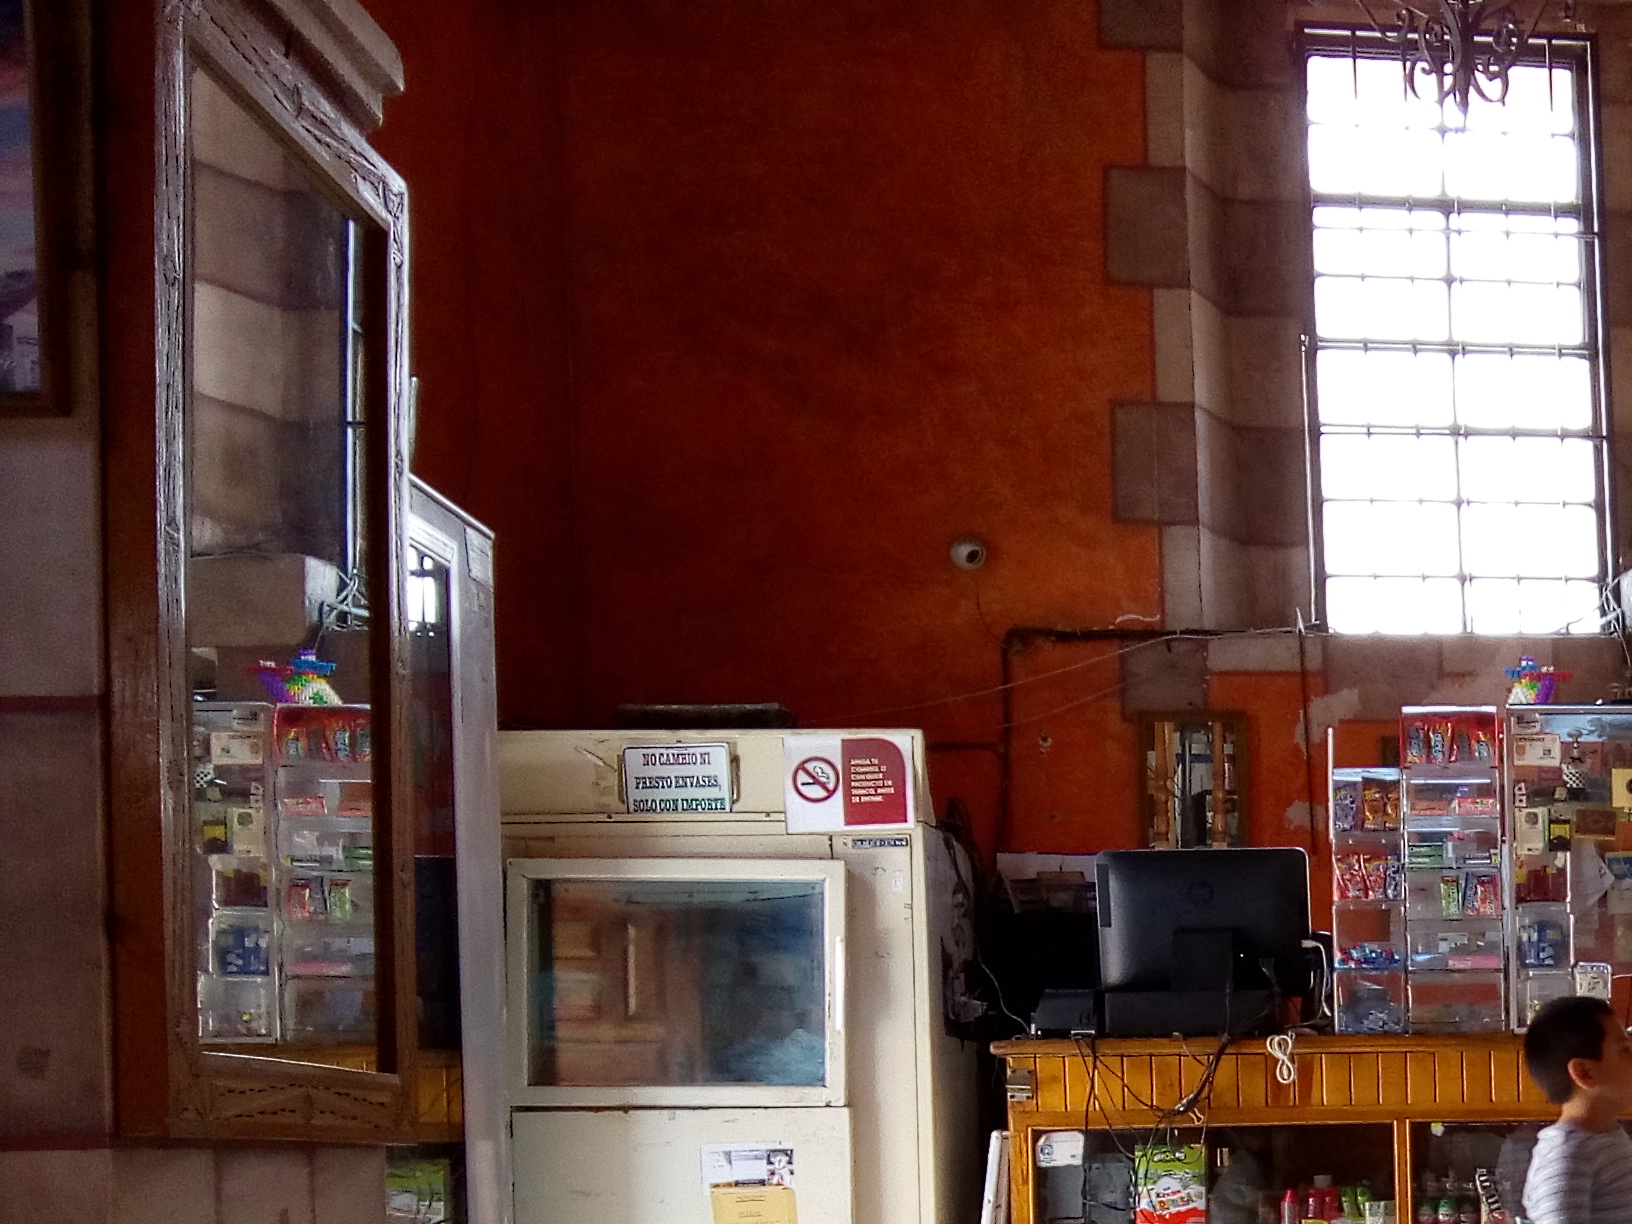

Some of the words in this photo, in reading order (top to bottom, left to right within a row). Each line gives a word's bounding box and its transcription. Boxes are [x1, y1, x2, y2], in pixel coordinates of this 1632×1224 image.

[643, 753, 656, 766] NO
[659, 753, 698, 766] CAMBIO
[699, 752, 711, 765] NI
[634, 776, 672, 790] PRESTO
[633, 799, 657, 813] SOLO
[659, 799, 679, 811] CON
[681, 798, 726, 812] IMPORTE
